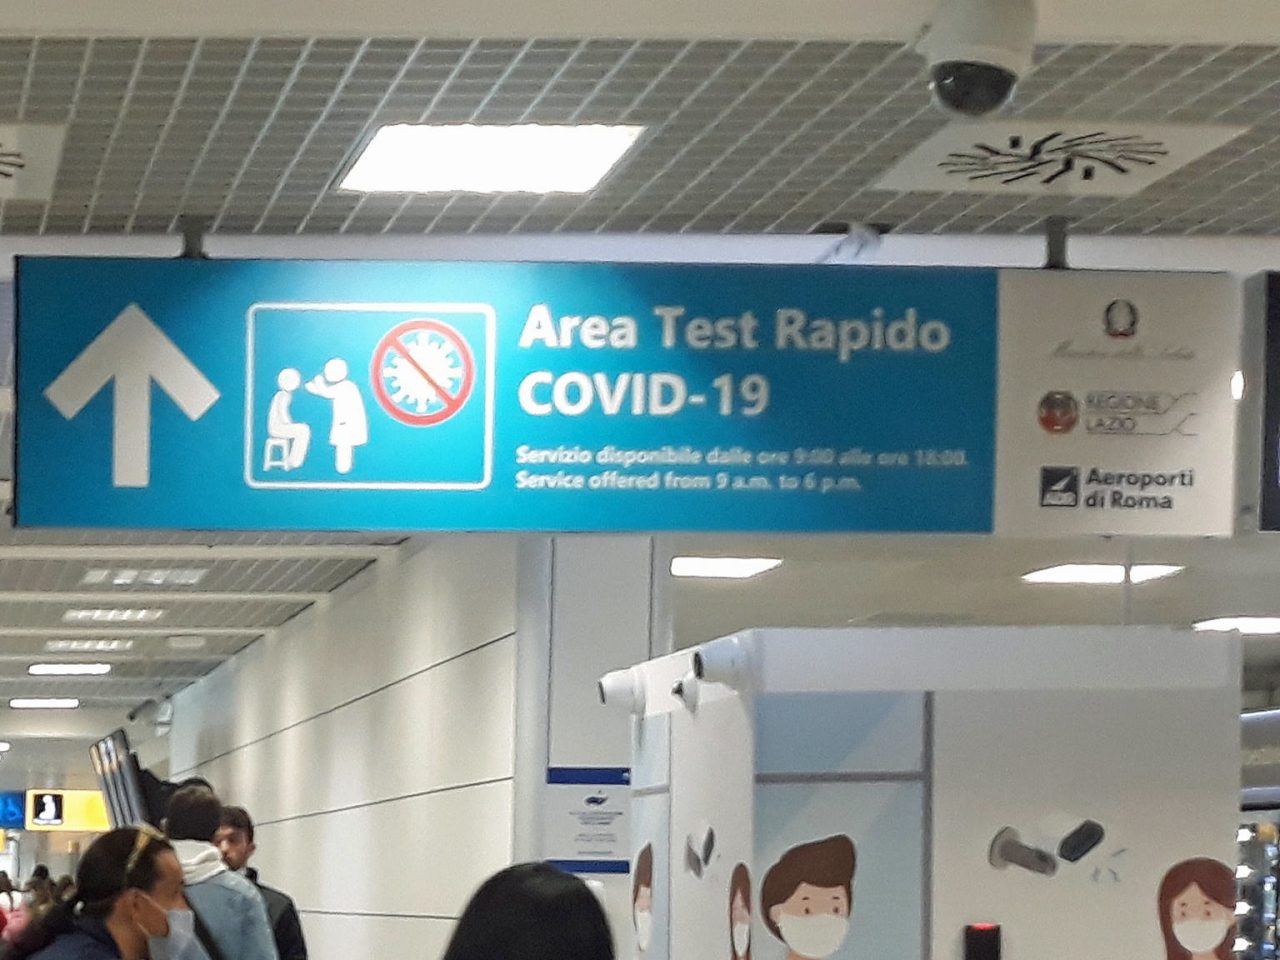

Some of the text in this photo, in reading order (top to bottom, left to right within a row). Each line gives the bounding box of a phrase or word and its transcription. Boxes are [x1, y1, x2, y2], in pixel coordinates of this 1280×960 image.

[520, 304, 951, 363] Area Test Rapido
[519, 371, 770, 416] COVID-19
[516, 445, 592, 464] Servizio
[516, 470, 584, 488] Service
[588, 470, 660, 489] offered
[664, 471, 710, 488] from
[716, 472, 729, 488] 9
[778, 474, 799, 489] to
[803, 472, 816, 489] 6
[1086, 468, 1194, 491] Aeroporti
[1086, 491, 1173, 509] di Roma
